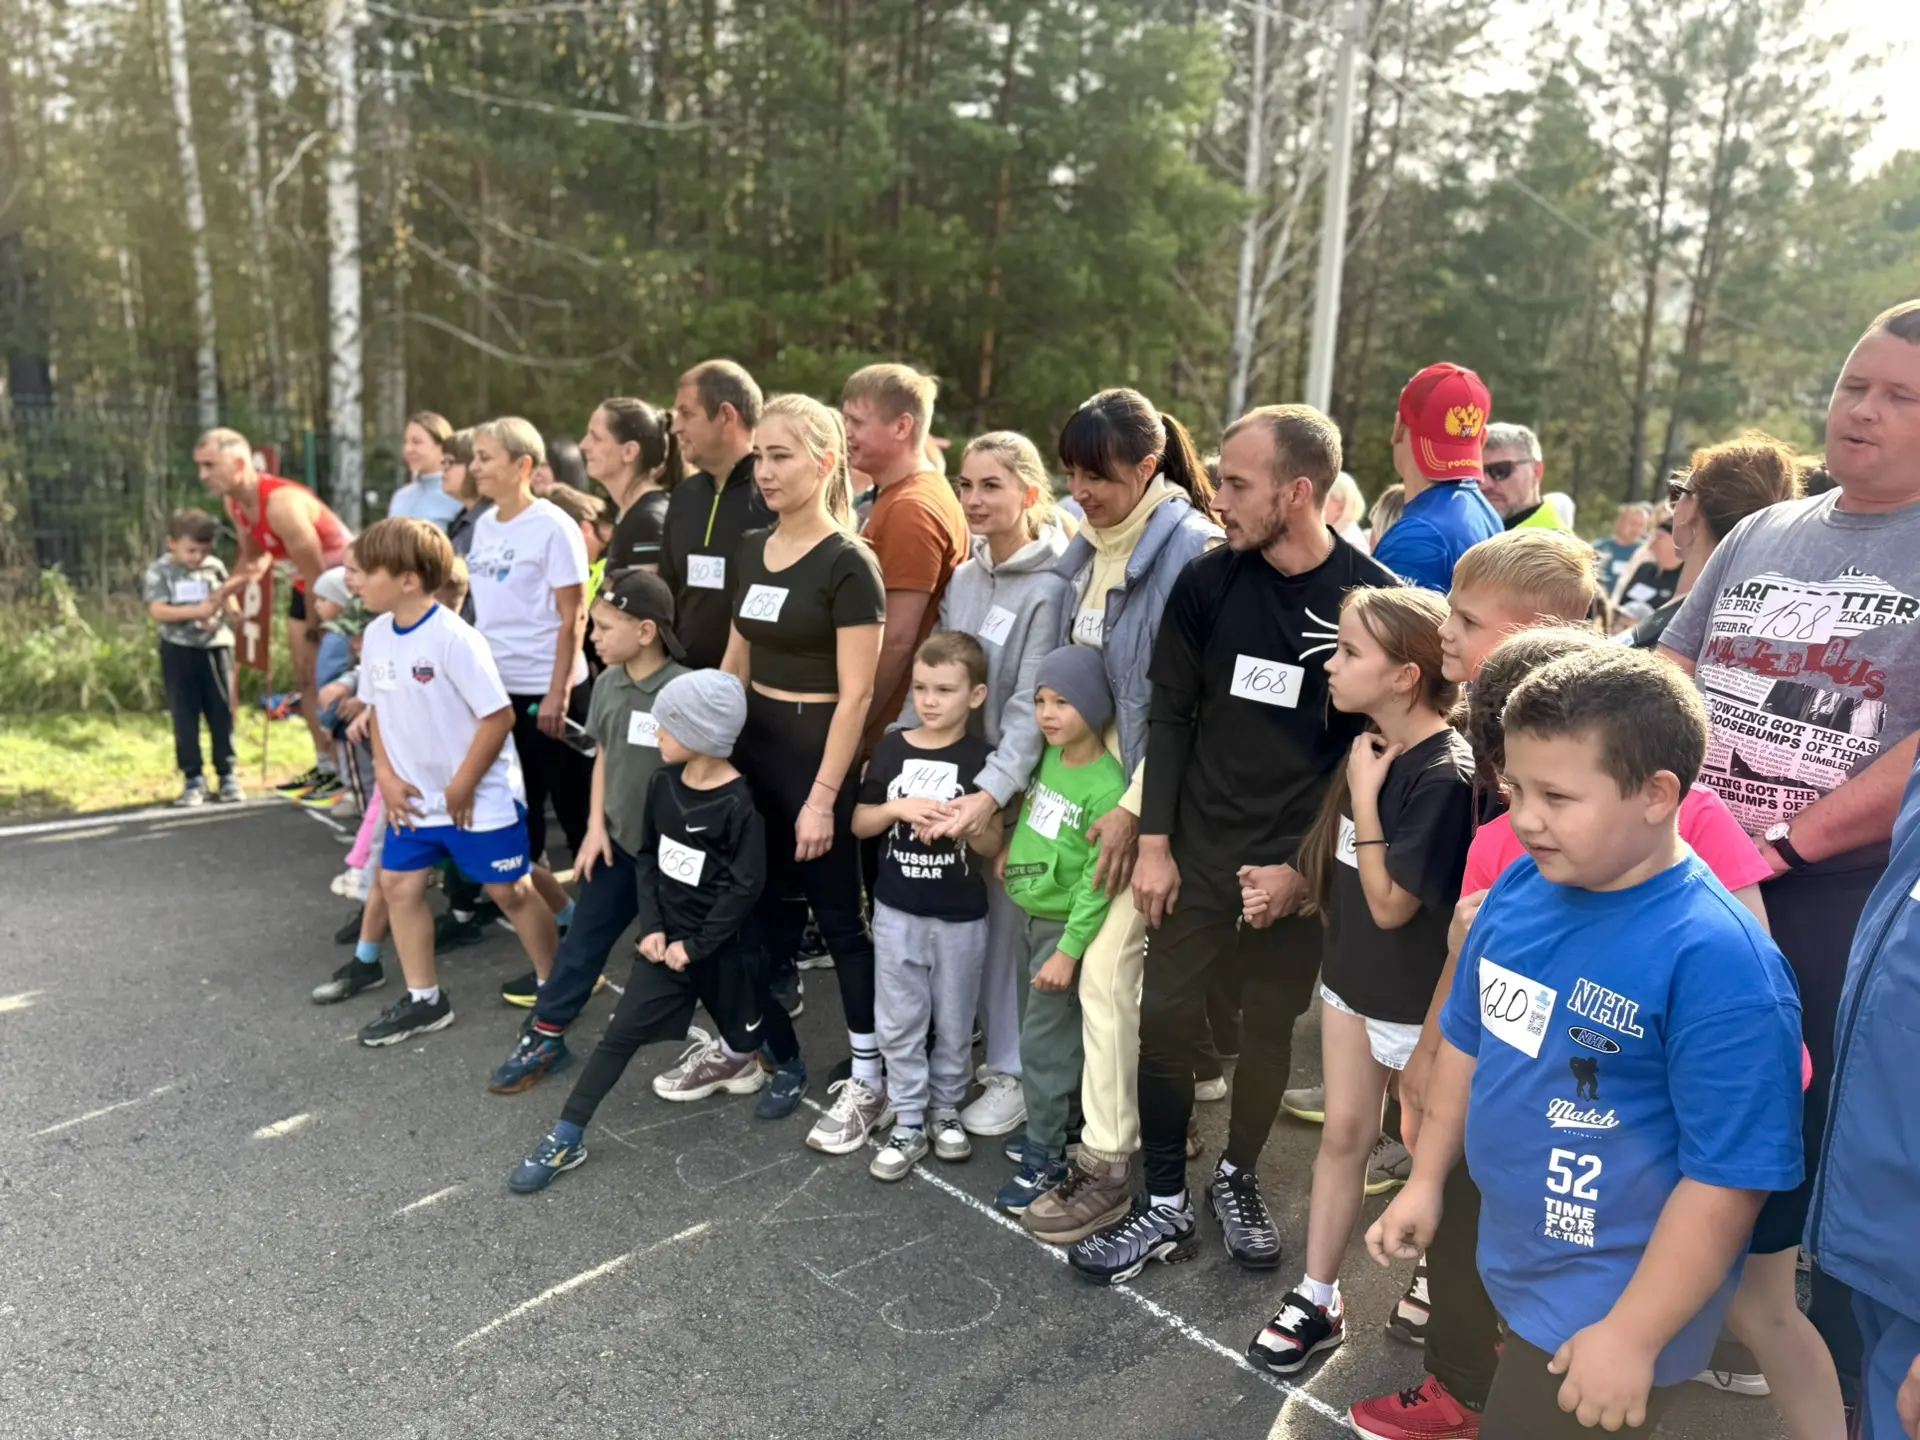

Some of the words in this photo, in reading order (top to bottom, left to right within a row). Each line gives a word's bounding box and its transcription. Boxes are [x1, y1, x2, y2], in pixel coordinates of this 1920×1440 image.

[747, 593, 780, 617] 156
[1077, 615, 1104, 637] 171
[1760, 600, 1831, 640] 158
[1836, 611, 1912, 626] ZKABA
[1241, 666, 1287, 694] 168
[1771, 719, 1807, 737] GOT
[1812, 728, 1844, 745] THE
[1806, 741, 1828, 754] OF
[908, 767, 949, 791] 141
[1745, 783, 1778, 798] GOT
[1784, 788, 1815, 801] THE
[661, 848, 698, 876] 156
[901, 865, 942, 879] BEAR
[1481, 978, 1528, 1022] 120
[1567, 977, 1644, 1039] NHL
[1577, 1029, 1608, 1052] NHL
[1546, 1098, 1620, 1128] Match
[1546, 1148, 1602, 1201] 52
[1544, 1197, 1596, 1221] TIME
[1545, 1212, 1595, 1235] FOR
[1544, 1227, 1595, 1248] ACTION
